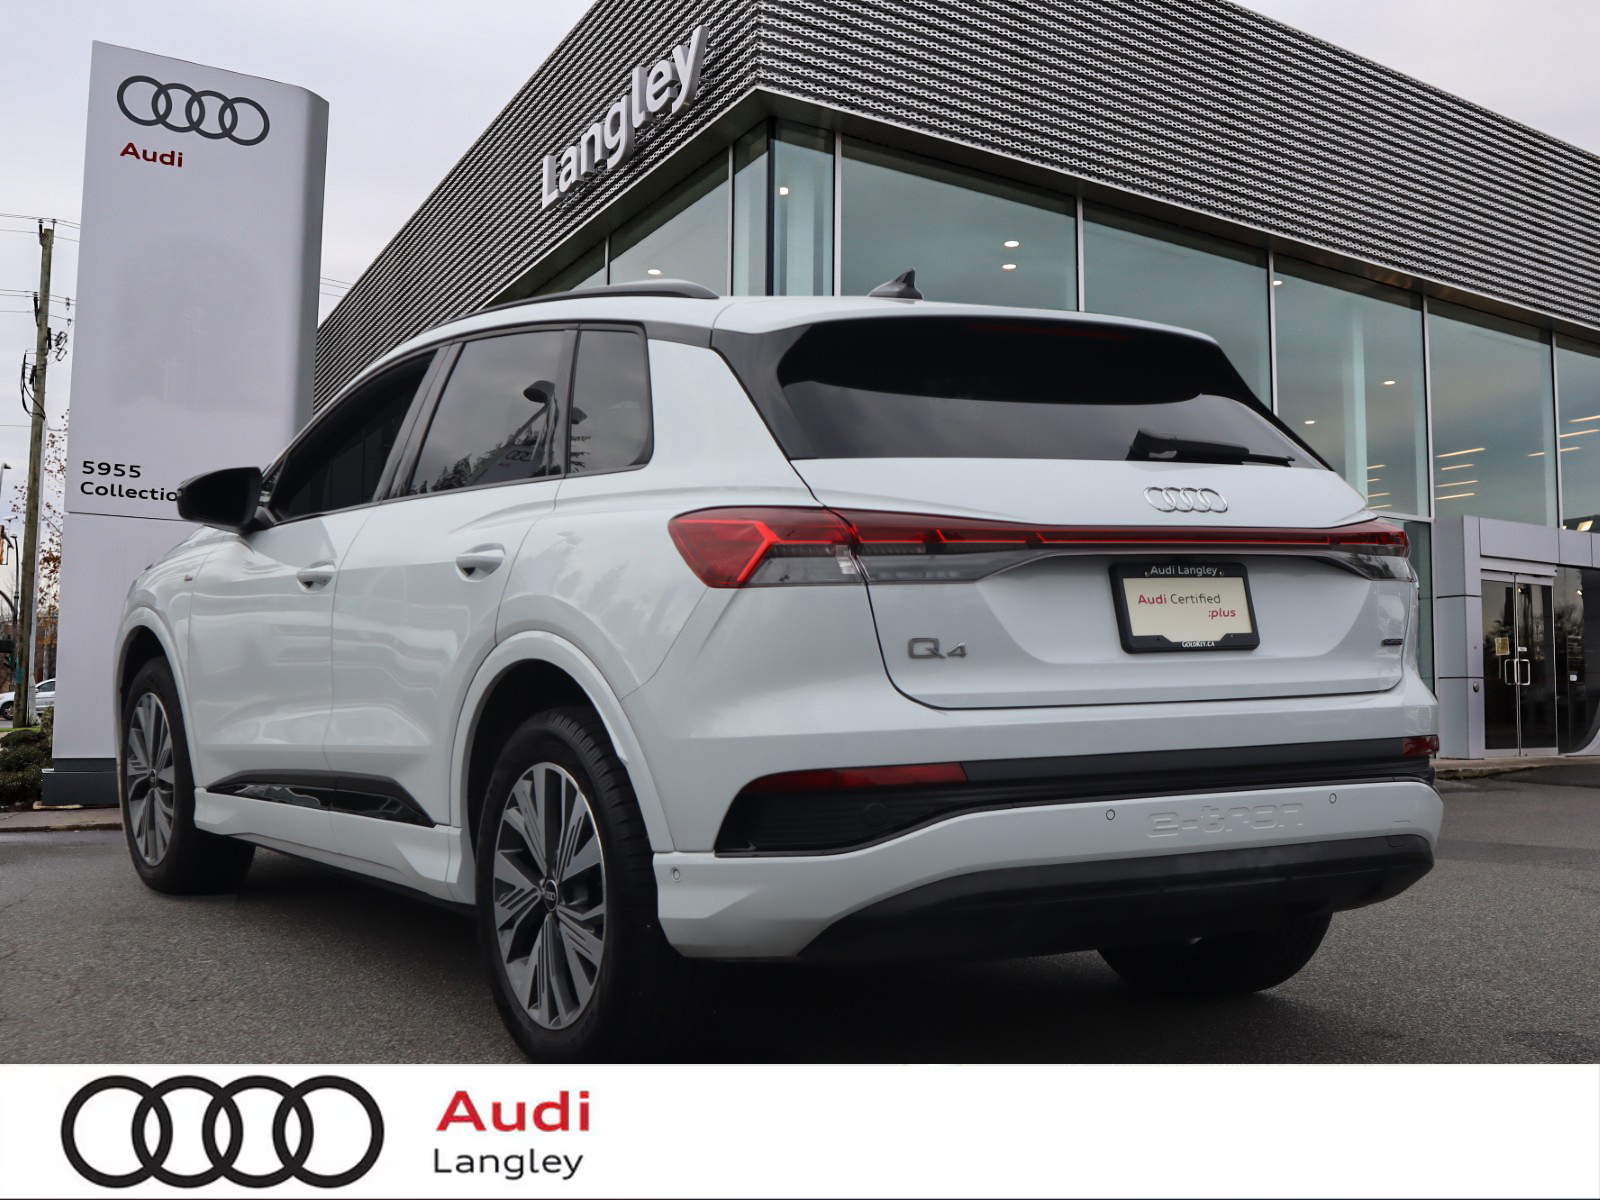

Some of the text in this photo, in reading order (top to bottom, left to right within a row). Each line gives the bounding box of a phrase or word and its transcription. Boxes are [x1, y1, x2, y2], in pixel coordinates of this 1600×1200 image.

[541, 25, 709, 210] Langley
[120, 142, 183, 167] Audi
[82, 460, 141, 478] 5955
[1150, 565, 1218, 576] Audi Langley
[1138, 593, 1221, 605] Audi Certified
[1147, 803, 1304, 838] e-tron
